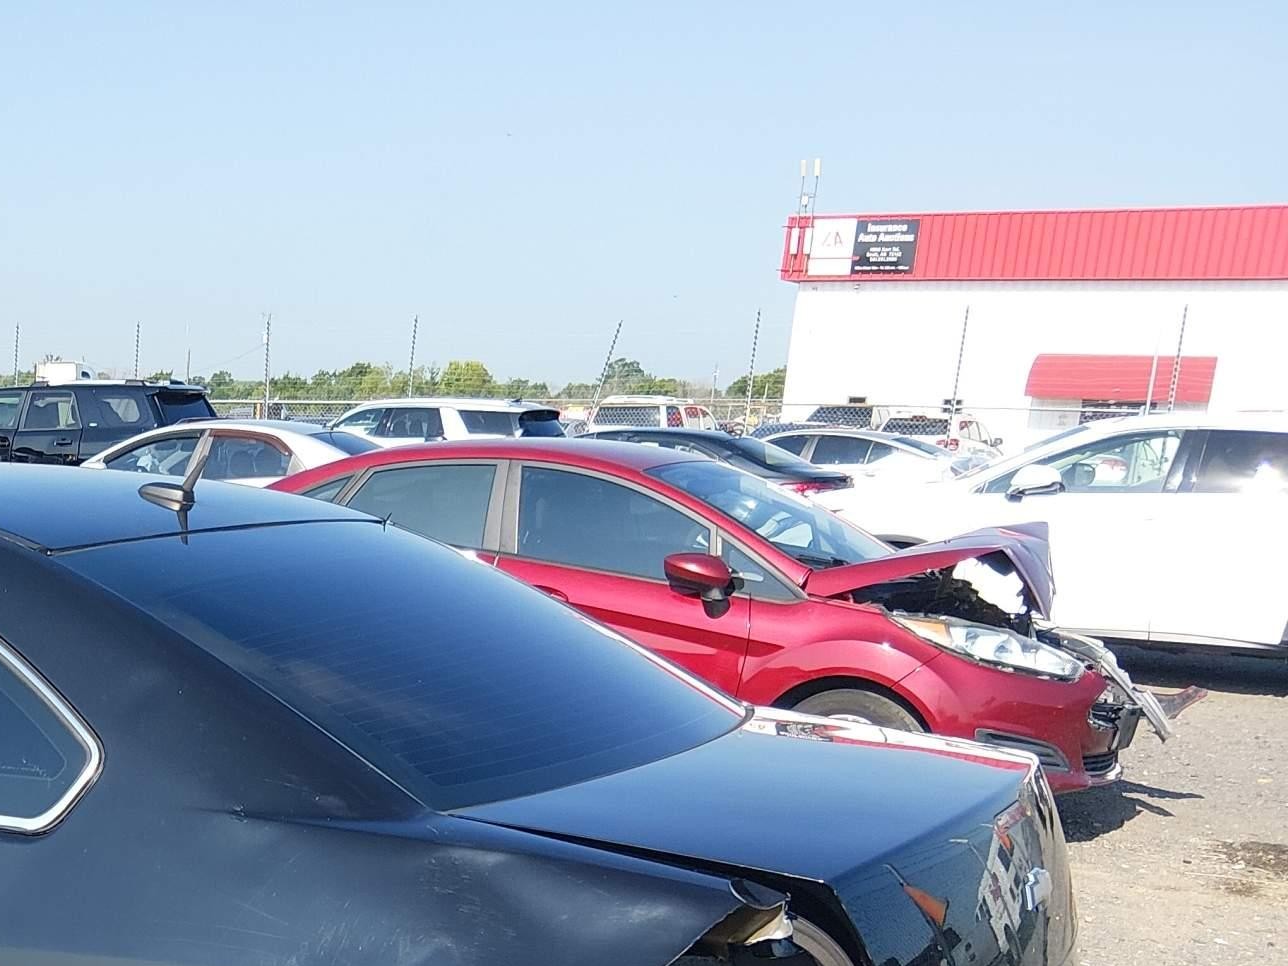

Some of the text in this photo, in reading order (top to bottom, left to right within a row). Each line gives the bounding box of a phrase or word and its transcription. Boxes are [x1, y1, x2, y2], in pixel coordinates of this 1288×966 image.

[867, 223, 908, 232] Insurance
[857, 232, 915, 242] Auto Auctions
